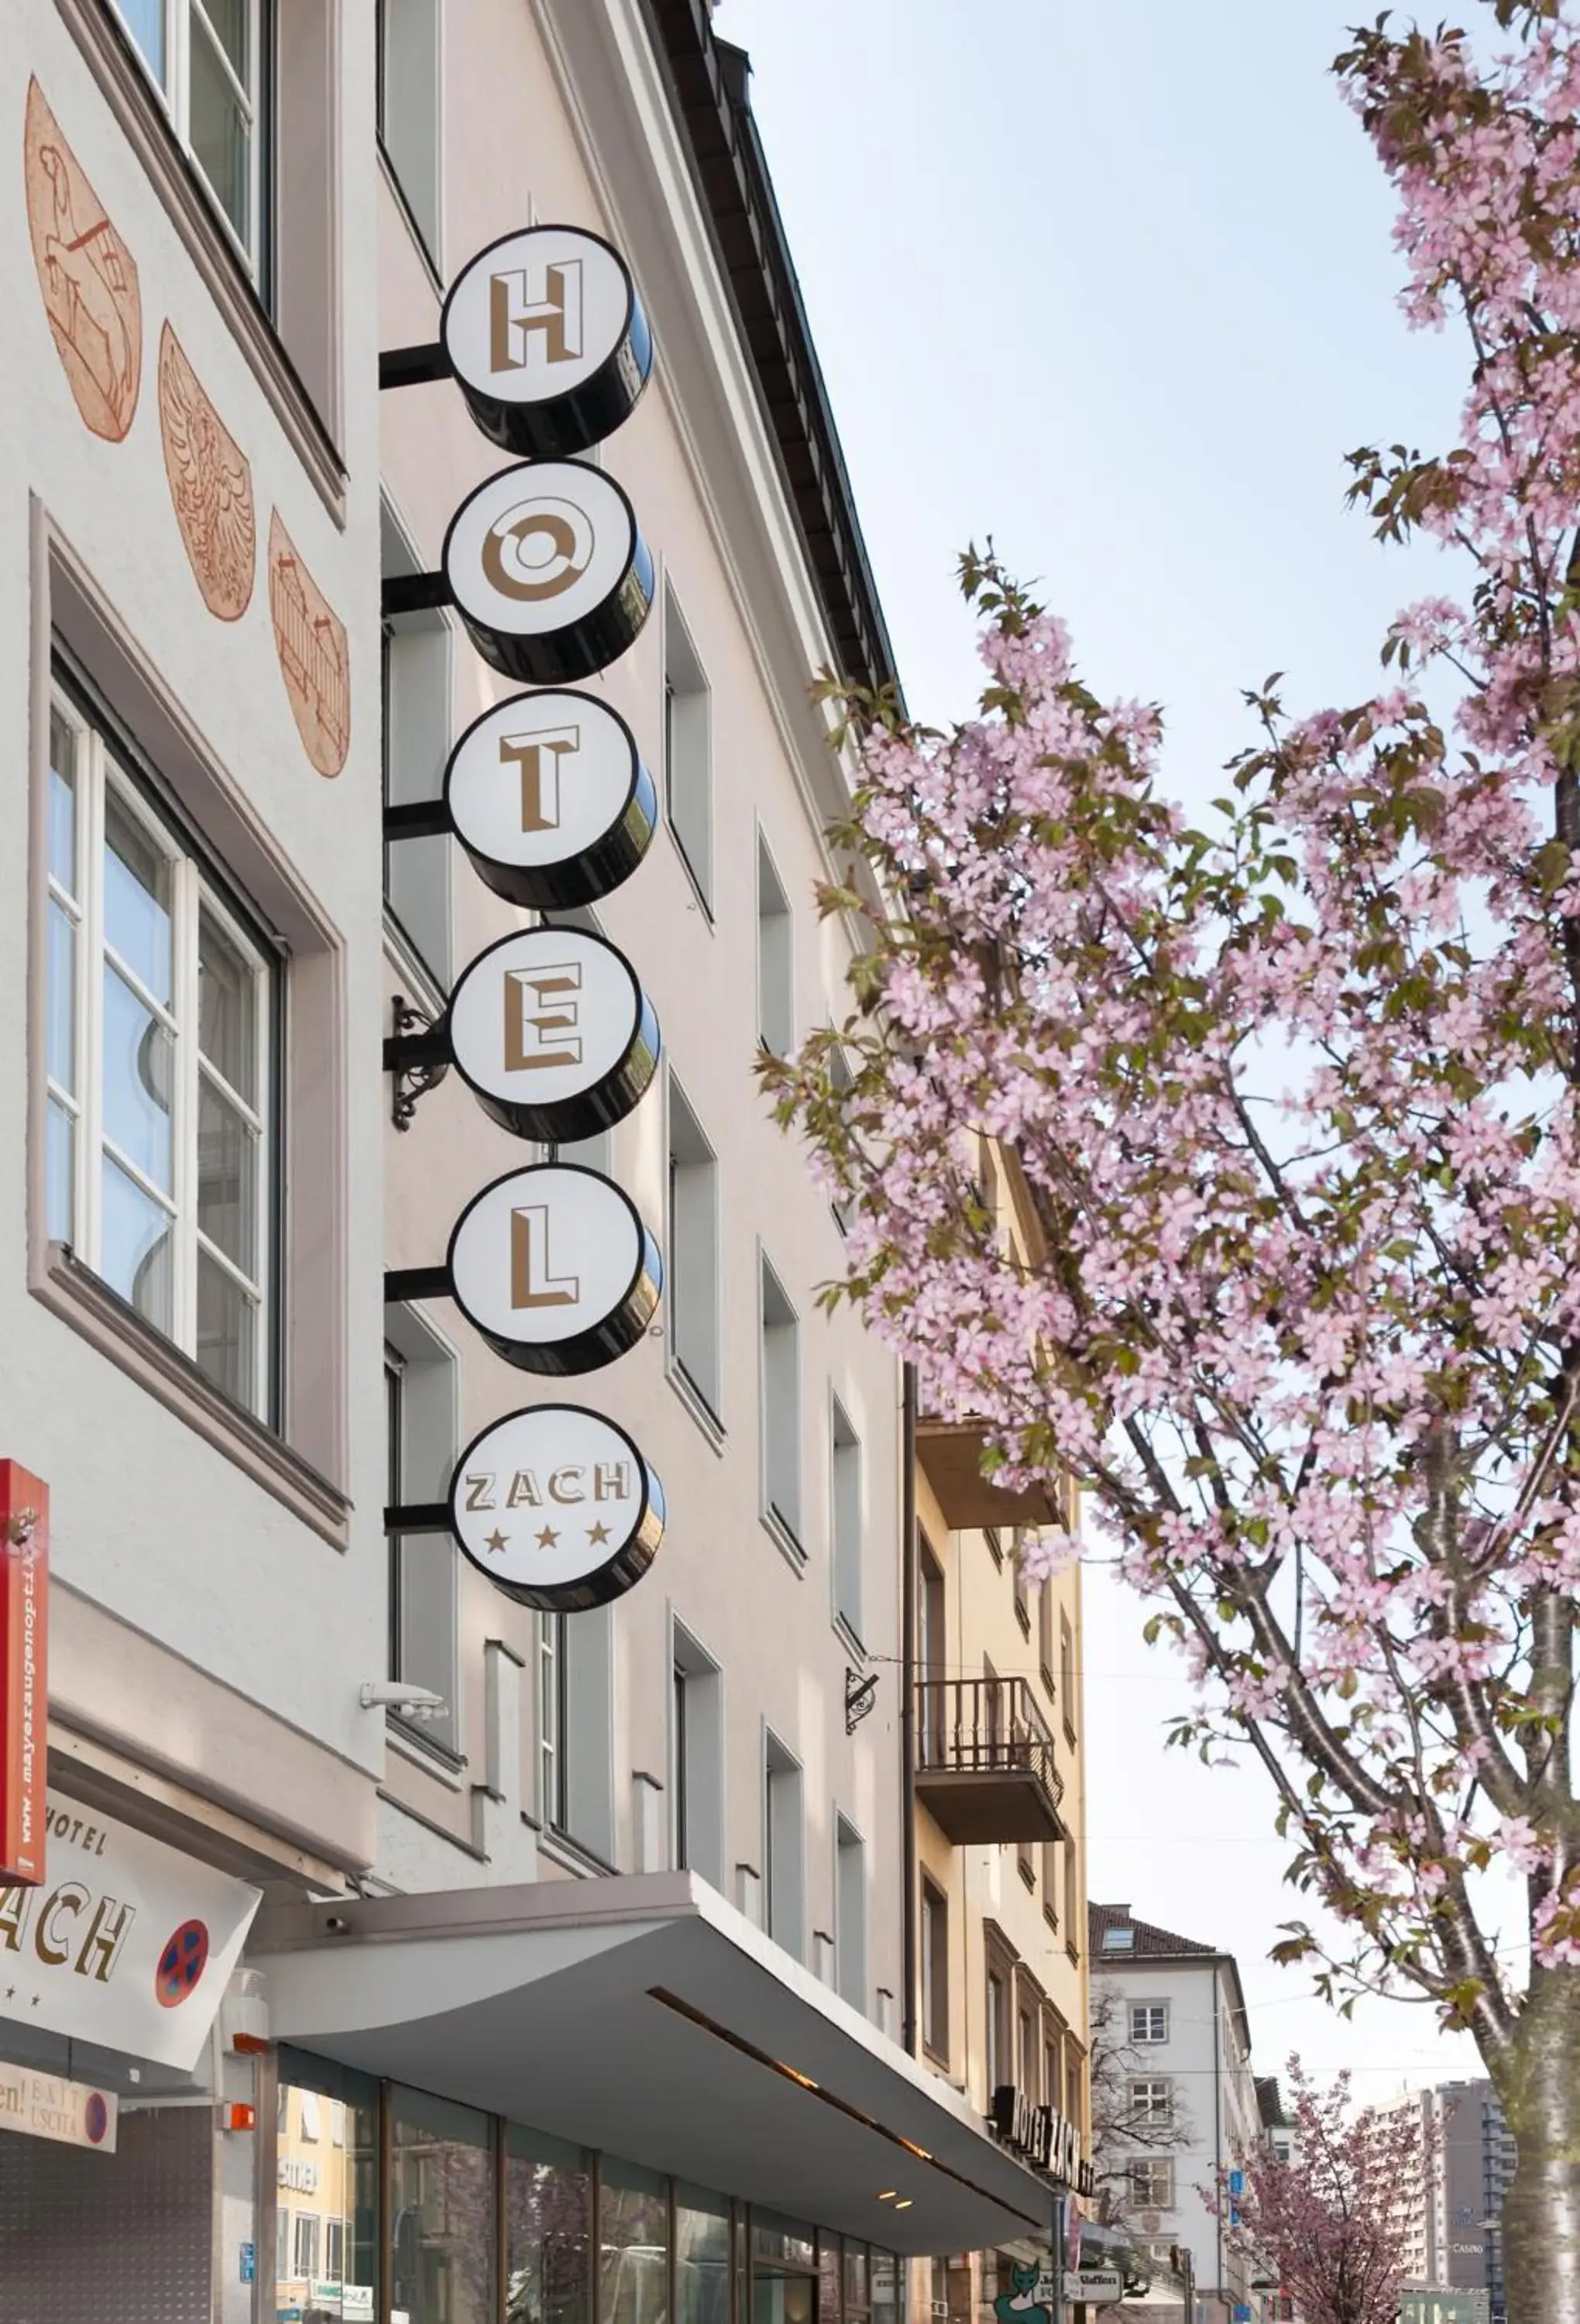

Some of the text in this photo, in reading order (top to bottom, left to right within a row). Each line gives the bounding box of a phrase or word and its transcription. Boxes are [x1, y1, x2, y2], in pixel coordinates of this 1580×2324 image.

[482, 259, 594, 1310] HOTEL
[465, 1461, 630, 1511] ZACH
[33, 2078, 78, 2110] EXIT
